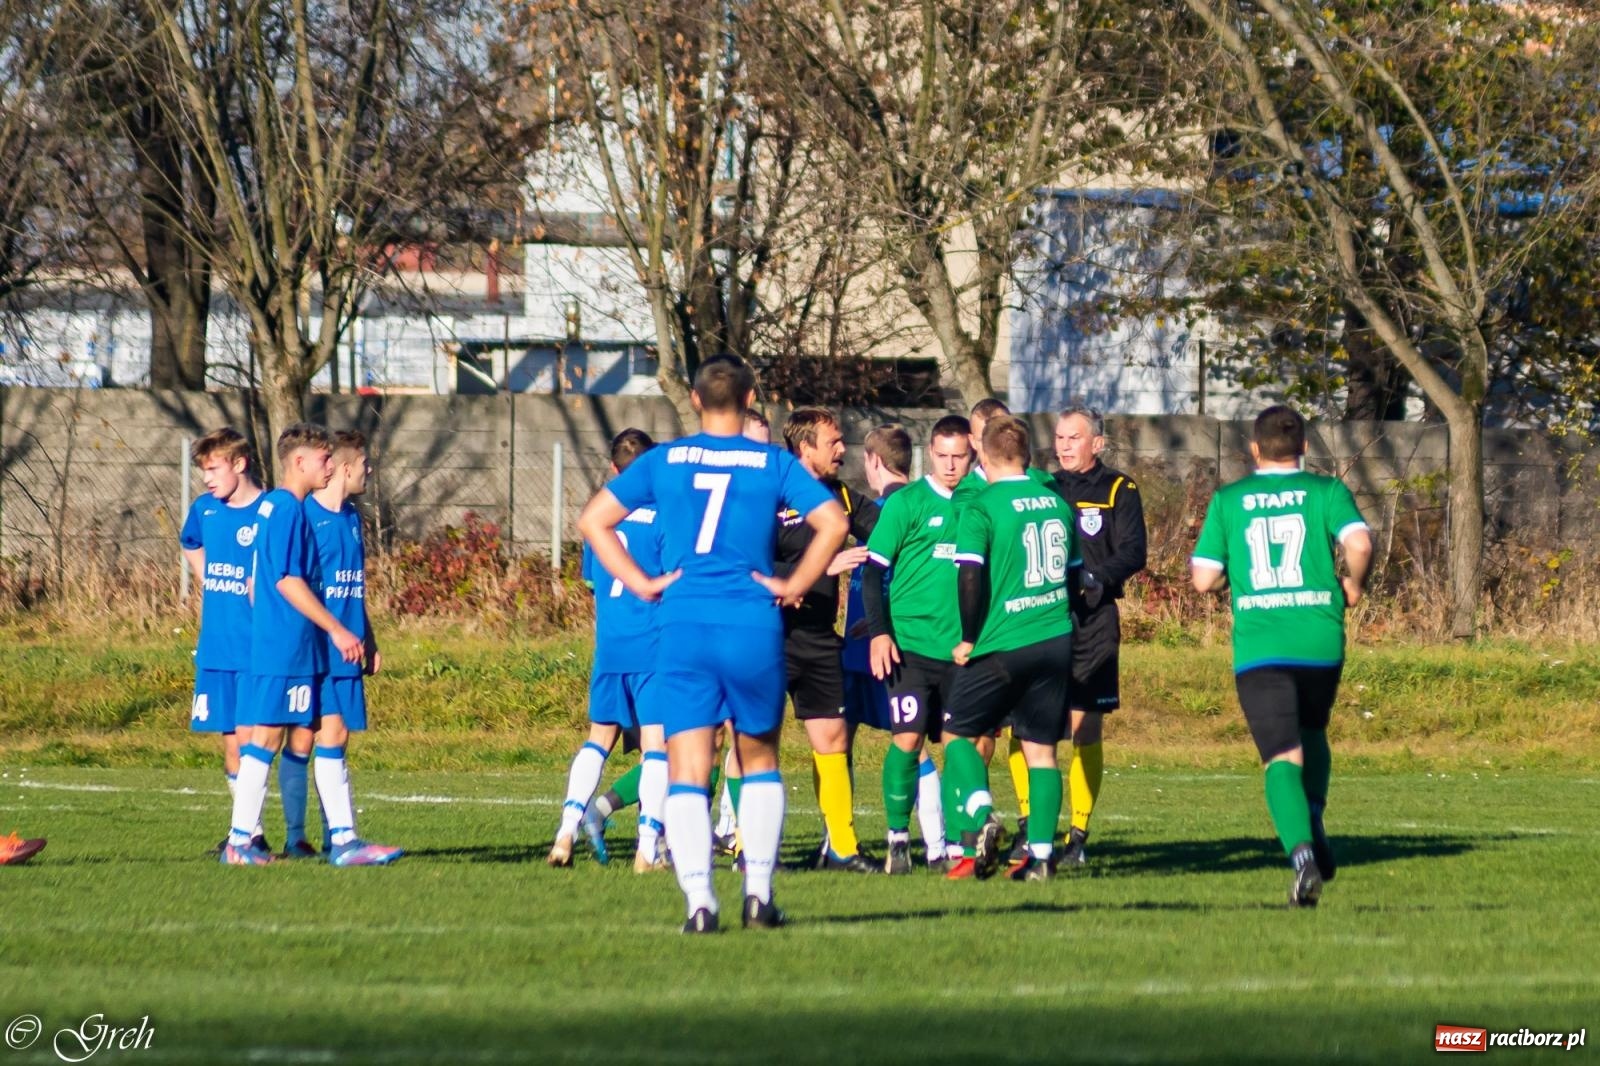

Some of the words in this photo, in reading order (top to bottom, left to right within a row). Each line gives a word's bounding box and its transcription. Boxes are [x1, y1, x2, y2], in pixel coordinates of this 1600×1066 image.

[693, 473, 731, 553] 7
[1012, 496, 1058, 512] START
[1242, 490, 1307, 511] START
[1023, 519, 1068, 588] 16
[1245, 513, 1306, 591] 17
[287, 685, 311, 713] 10
[890, 695, 918, 723] 19
